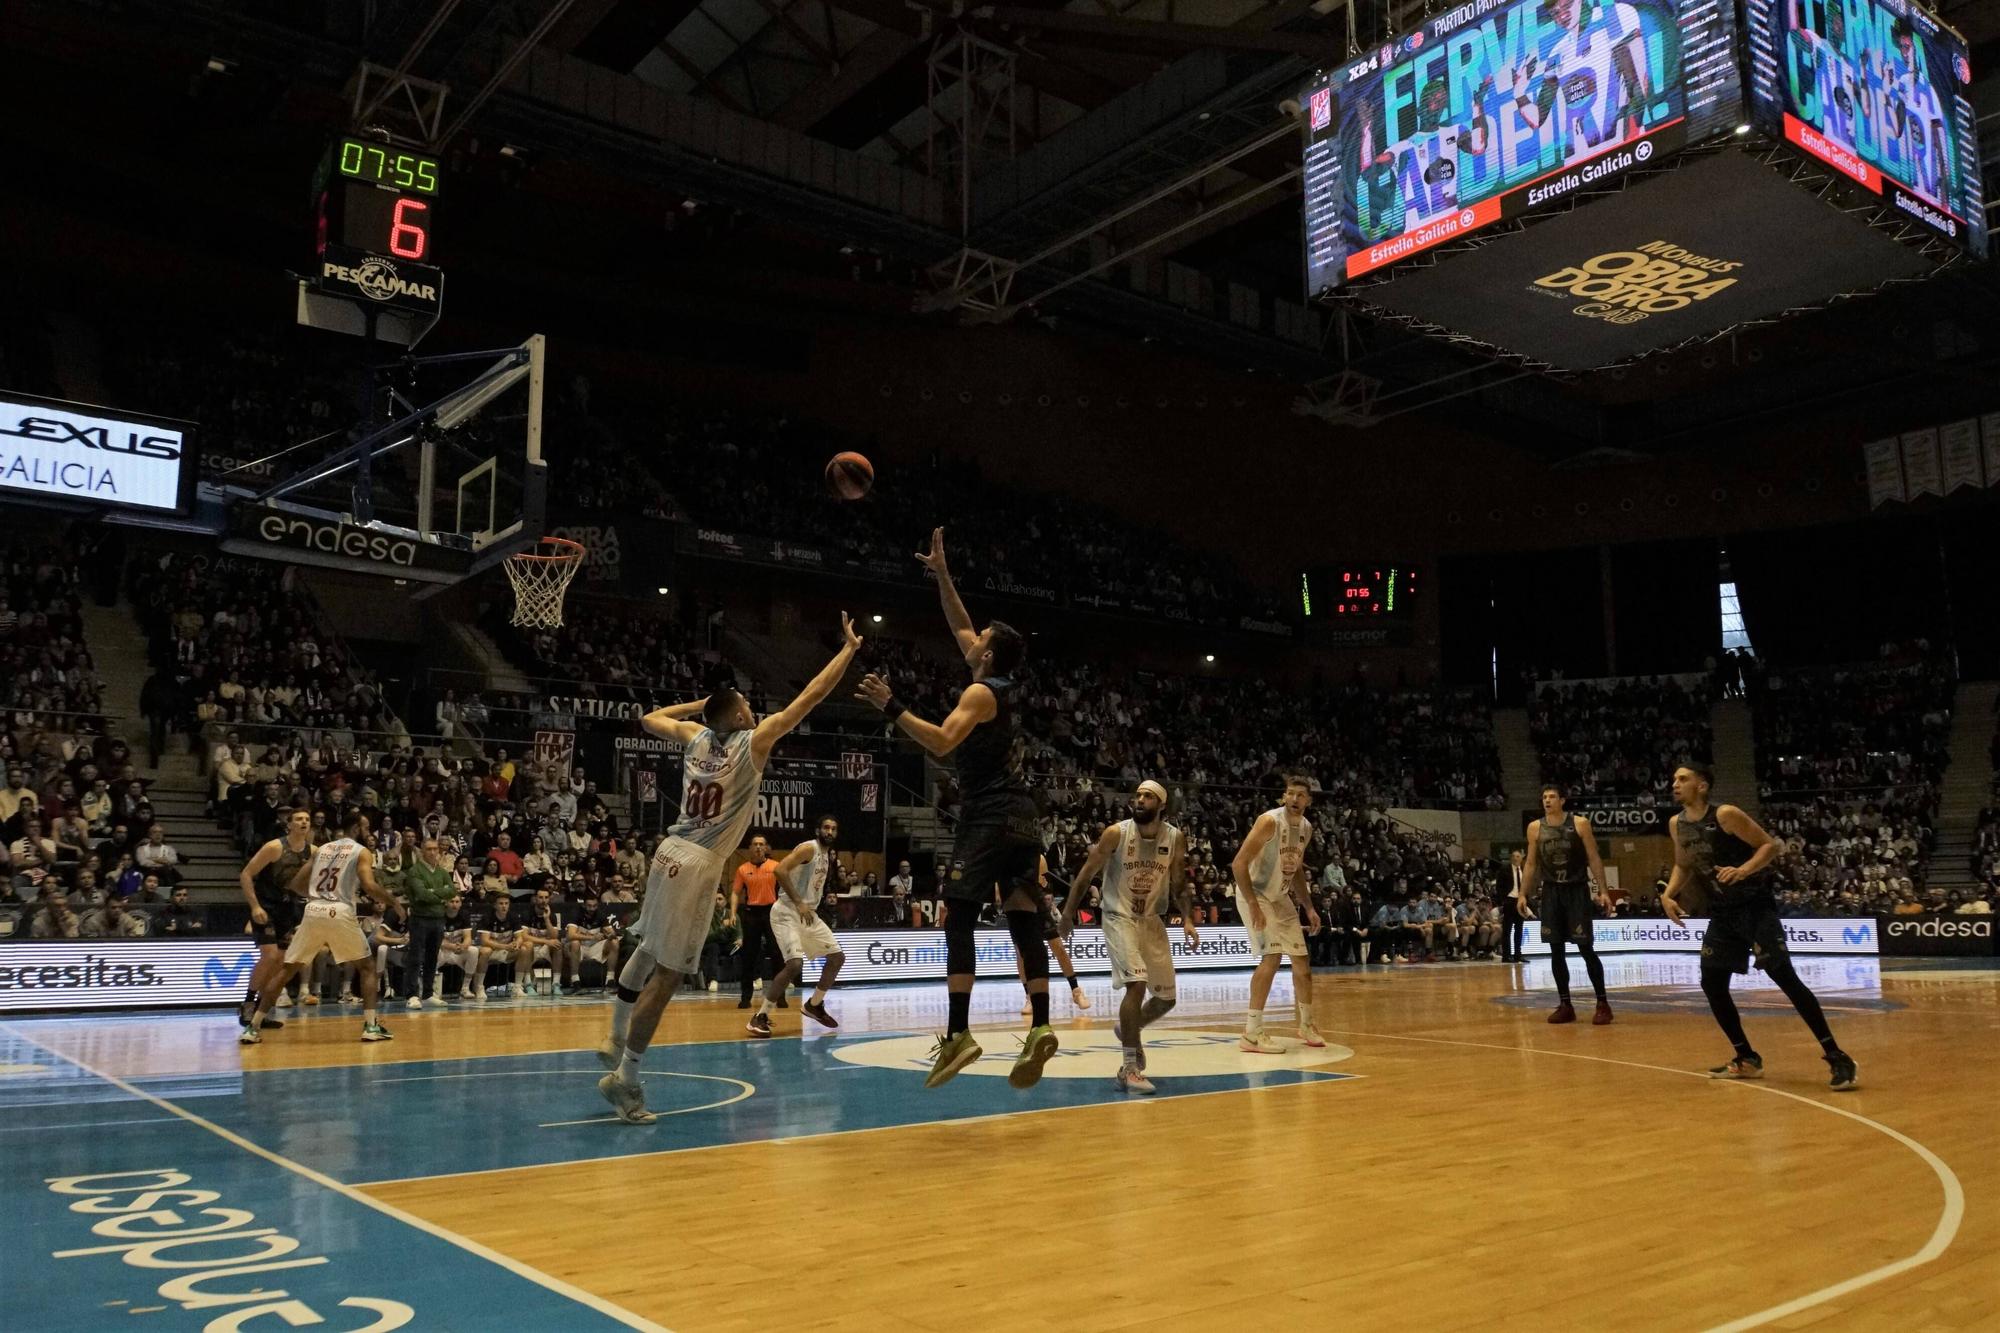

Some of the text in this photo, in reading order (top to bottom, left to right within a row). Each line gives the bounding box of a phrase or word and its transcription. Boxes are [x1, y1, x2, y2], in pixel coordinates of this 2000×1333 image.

[1434, 2, 1475, 38] PARTIDO
[1800, 128, 1831, 159] Estrella
[340, 142, 437, 192] 07:55
[1528, 151, 1633, 206] Estrella Galicia
[1895, 190, 1924, 219] Estrella
[390, 198, 427, 259] 6
[1370, 218, 1458, 264] Estrella Galicia
[1636, 239, 1745, 274] MONBUS
[323, 262, 437, 302] PESCAMAR
[1533, 266, 1692, 313] DOIRO
[1582, 251, 1739, 301] OBRA
[0, 453, 118, 495] ALICIA
[260, 515, 417, 567] endesa
[549, 695, 644, 720] SNTIAGO
[614, 736, 682, 751] OBRADOIRO
[752, 794, 805, 829] RA!!!
[315, 867, 341, 892] 23
[1634, 925, 1690, 942] decides
[1887, 917, 1991, 938] endesa
[867, 940, 909, 965] Con
[0, 954, 164, 987] ecesitas.
